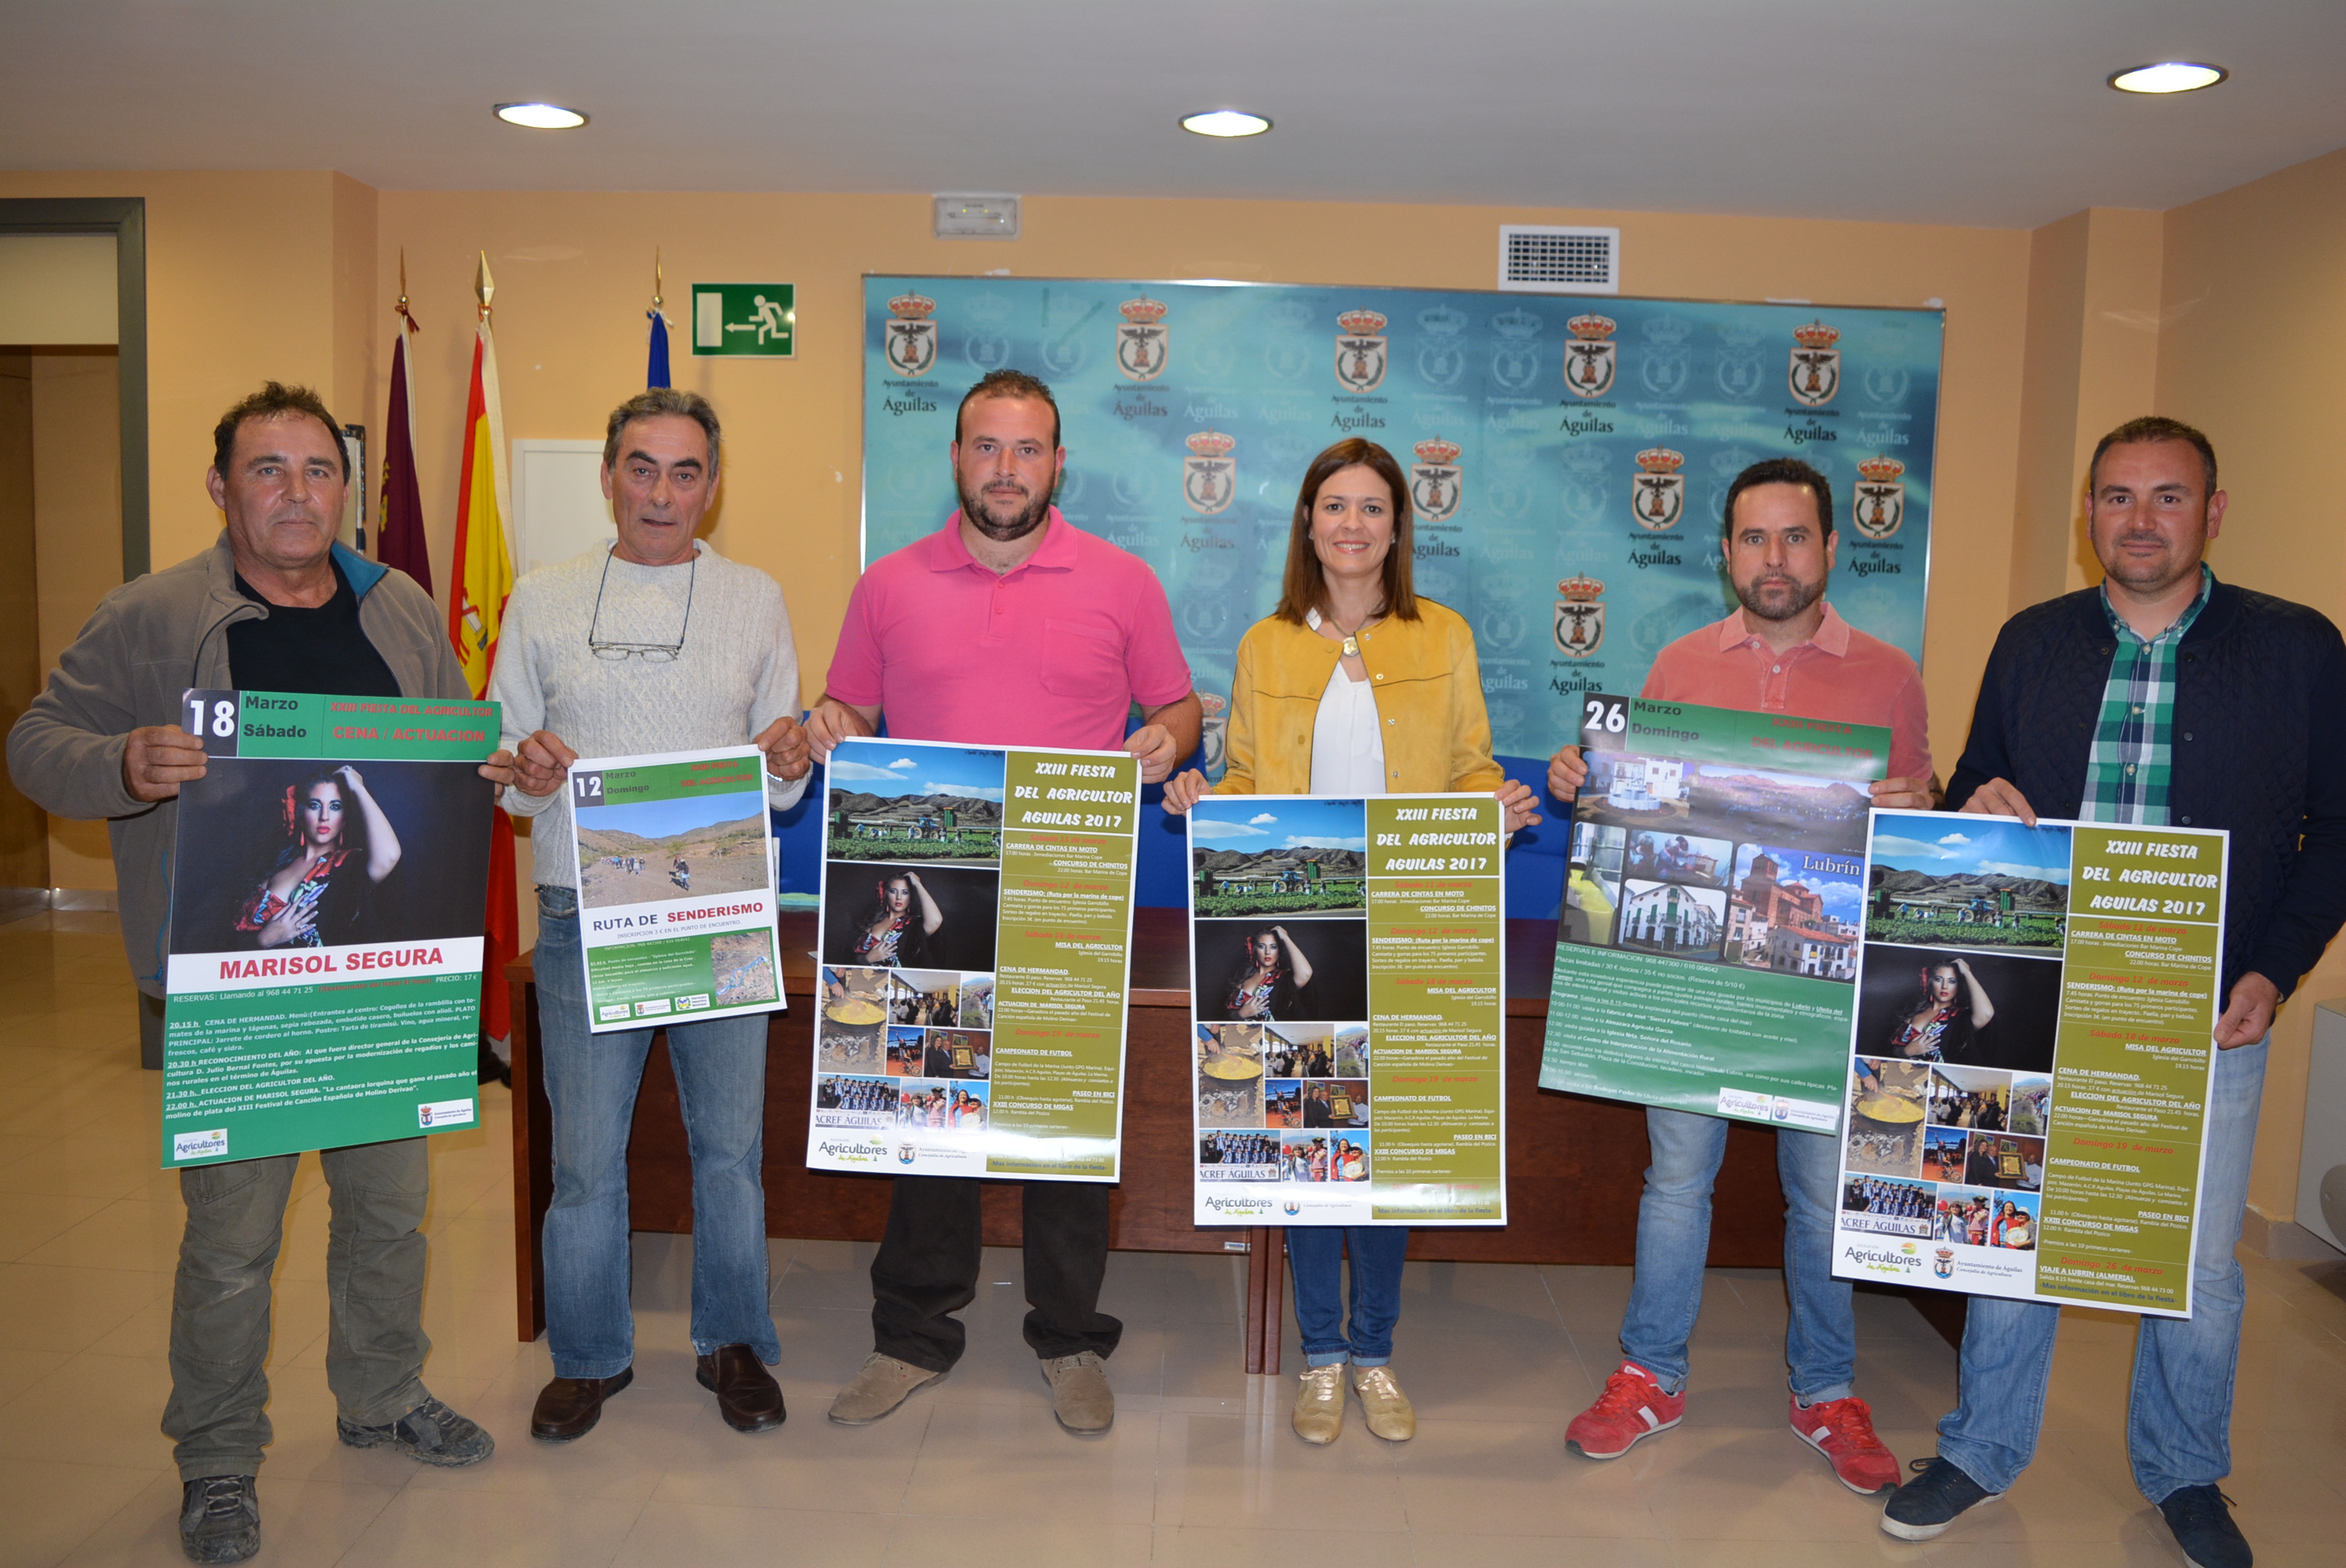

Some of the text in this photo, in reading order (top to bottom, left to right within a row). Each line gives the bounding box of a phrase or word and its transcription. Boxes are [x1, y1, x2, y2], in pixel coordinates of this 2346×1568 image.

[882, 379, 939, 390] Ayuntamiento
[1113, 383, 1170, 394] Ayuntamiento
[905, 388, 916, 397] de
[1136, 394, 1146, 402] de
[1331, 394, 1388, 406] Ayuntamiento
[882, 395, 938, 416] Águilas
[1113, 399, 1168, 420] Águilas
[1354, 405, 1364, 414] de
[1559, 397, 1618, 408] Ayuntamiento
[1784, 407, 1840, 417] Ayuntamiento
[1331, 411, 1385, 431] Águilas
[1560, 416, 1614, 436] Águilas
[1784, 423, 1837, 444] Águilas
[1629, 532, 1684, 541] Ayuntamiento
[1651, 543, 1661, 551] de
[1848, 539, 1904, 550] Ayuntamiento
[1628, 549, 1682, 568] Águilas
[1871, 550, 1879, 559] de
[1847, 556, 1901, 577] Águilas
[1549, 659, 1605, 670] Ayuntamiento
[1572, 669, 1582, 677] de
[1549, 675, 1603, 696] Águilas
[245, 695, 298, 710] Marzo
[330, 702, 492, 717] XXIII FIESTA DEL AGRICULTOR
[1633, 700, 1681, 715] Marzo
[190, 699, 238, 737] 18
[1584, 700, 1629, 736] 26
[1771, 717, 1852, 734] XXIII FIESTA
[243, 723, 307, 738] Sábado
[332, 726, 379, 739] CENA
[392, 728, 485, 742] ACTUACION
[1632, 721, 1699, 740] Domingo
[1751, 736, 1873, 760] DEL AGRICULTOR
[605, 771, 636, 779] Marzo
[1034, 762, 1116, 778] XXIII FIESTA
[576, 776, 601, 797] 12
[681, 773, 753, 787] DEL AGRICULTOR
[606, 785, 649, 794] Domingo
[1014, 785, 1132, 804] DEL AGRICULTOR
[1021, 811, 1121, 827] AGUILAS 2017
[1395, 807, 1477, 821] XXIII FIESTA
[1376, 832, 1496, 846] DEL AGRICULTOR
[2104, 840, 2198, 859] XXIII FIESTA
[1385, 857, 1487, 870] AGUILAS 2017
[1801, 855, 1861, 876] Lubrín
[2082, 866, 2221, 889] DEL AGRICULTOR
[666, 902, 763, 922] SENDERISMO
[2090, 895, 2205, 916] AGUILAS 2017
[593, 913, 657, 931] RUTA DE
[617, 930, 653, 938] INSCRIPCION
[2070, 930, 2104, 938] CARRERA
[2115, 933, 2141, 942] CINTAS
[2154, 935, 2177, 944] MOTO
[220, 947, 443, 979] MARISOL SEGURA
[2124, 950, 2165, 960] CONCURSO
[2177, 954, 2212, 964] CHINITOS
[173, 993, 217, 1002] RESERVAS:
[220, 991, 256, 1000] Llamando
[166, 1090, 187, 1099] 21.30
[188, 1089, 197, 1098] h.
[201, 1085, 238, 1094] ELECCION
[255, 1078, 301, 1089] AGRICULTOR
[318, 1073, 335, 1082] AÑO.
[844, 1113, 881, 1126] ÁGUILAS
[176, 1138, 225, 1153] Agricultores
[819, 1142, 888, 1156] Agricultores
[1228, 1168, 1266, 1178] ÁGUILAS
[1204, 1196, 1273, 1210] Agricultores
[2137, 1210, 2161, 1220] PASEO
[2174, 1214, 2189, 1223] BICI
[1872, 1218, 1916, 1235] ÁGUILAS
[1845, 1247, 1921, 1267] Agricultores
